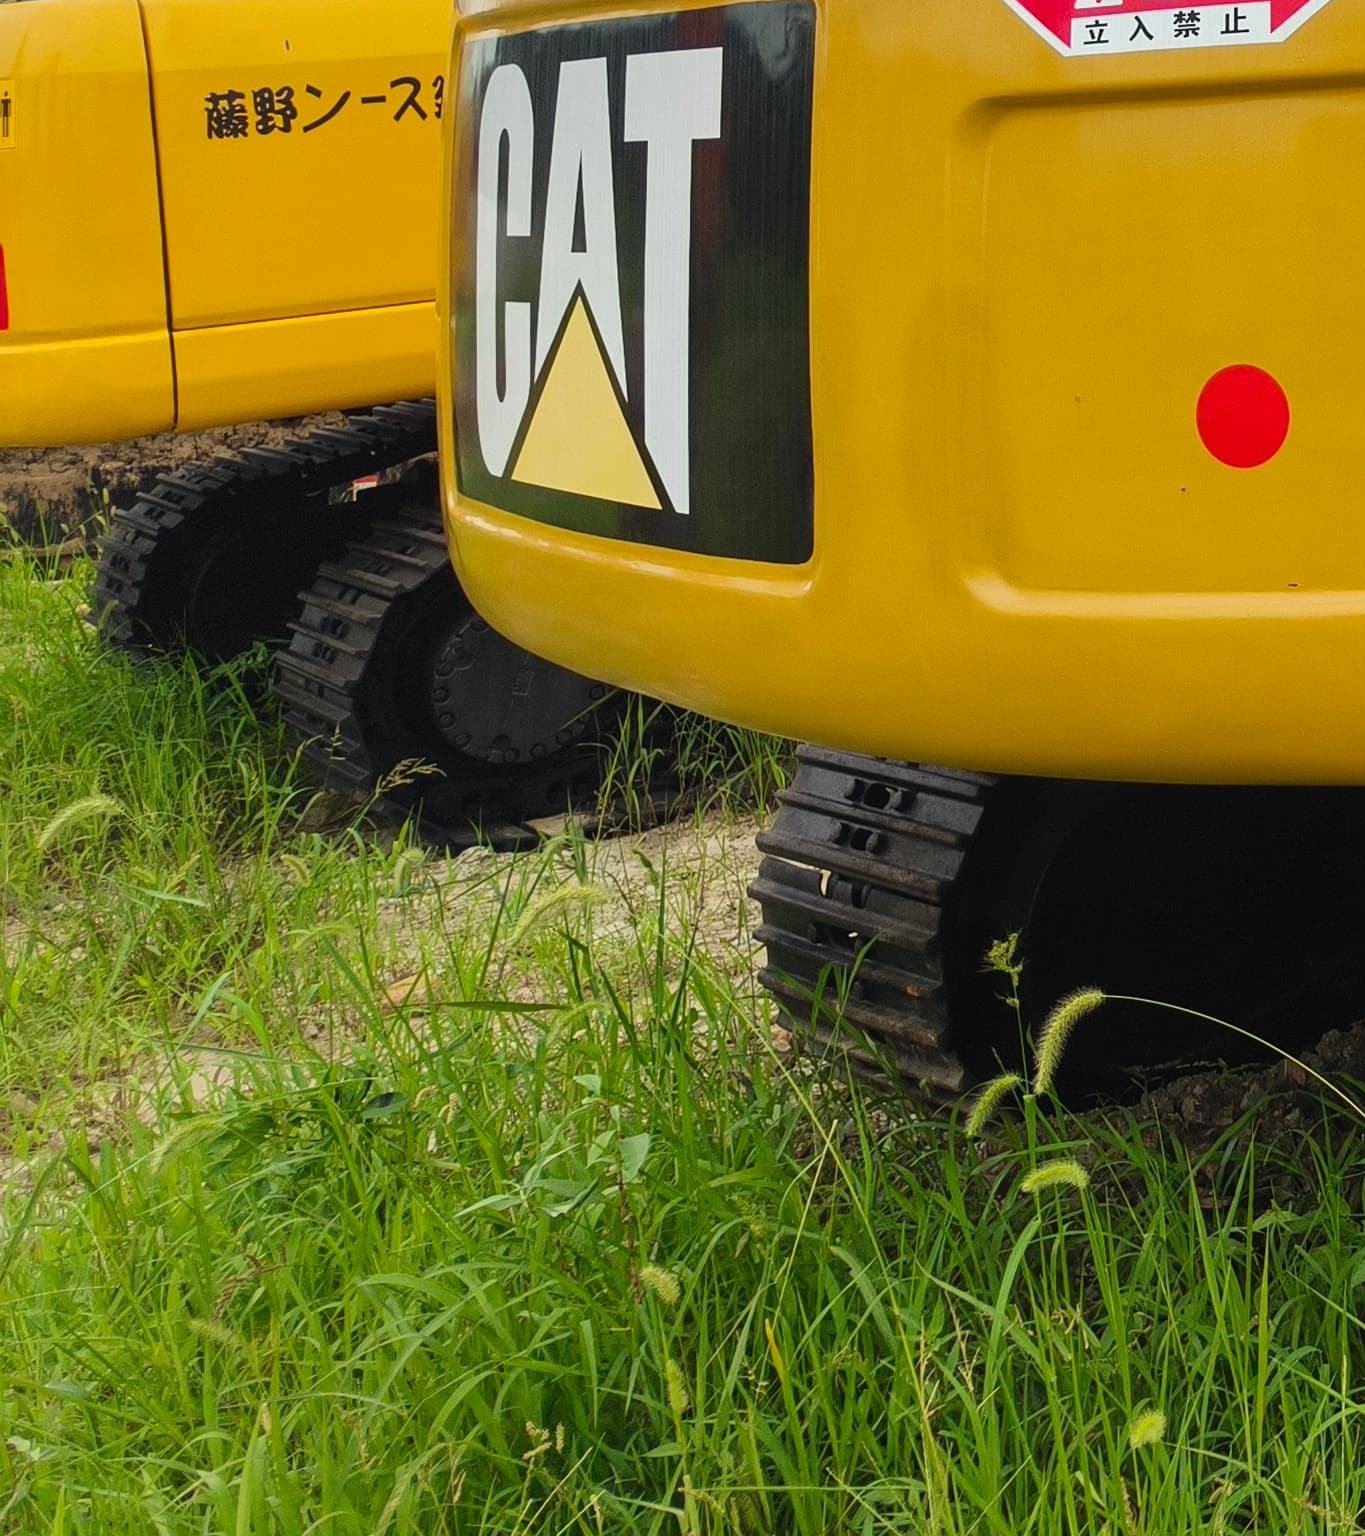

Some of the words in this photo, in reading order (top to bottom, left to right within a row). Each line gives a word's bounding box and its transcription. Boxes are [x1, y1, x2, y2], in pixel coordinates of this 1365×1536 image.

[1083, 6, 1250, 46] 立入禁止
[475, 46, 724, 515] CAT
